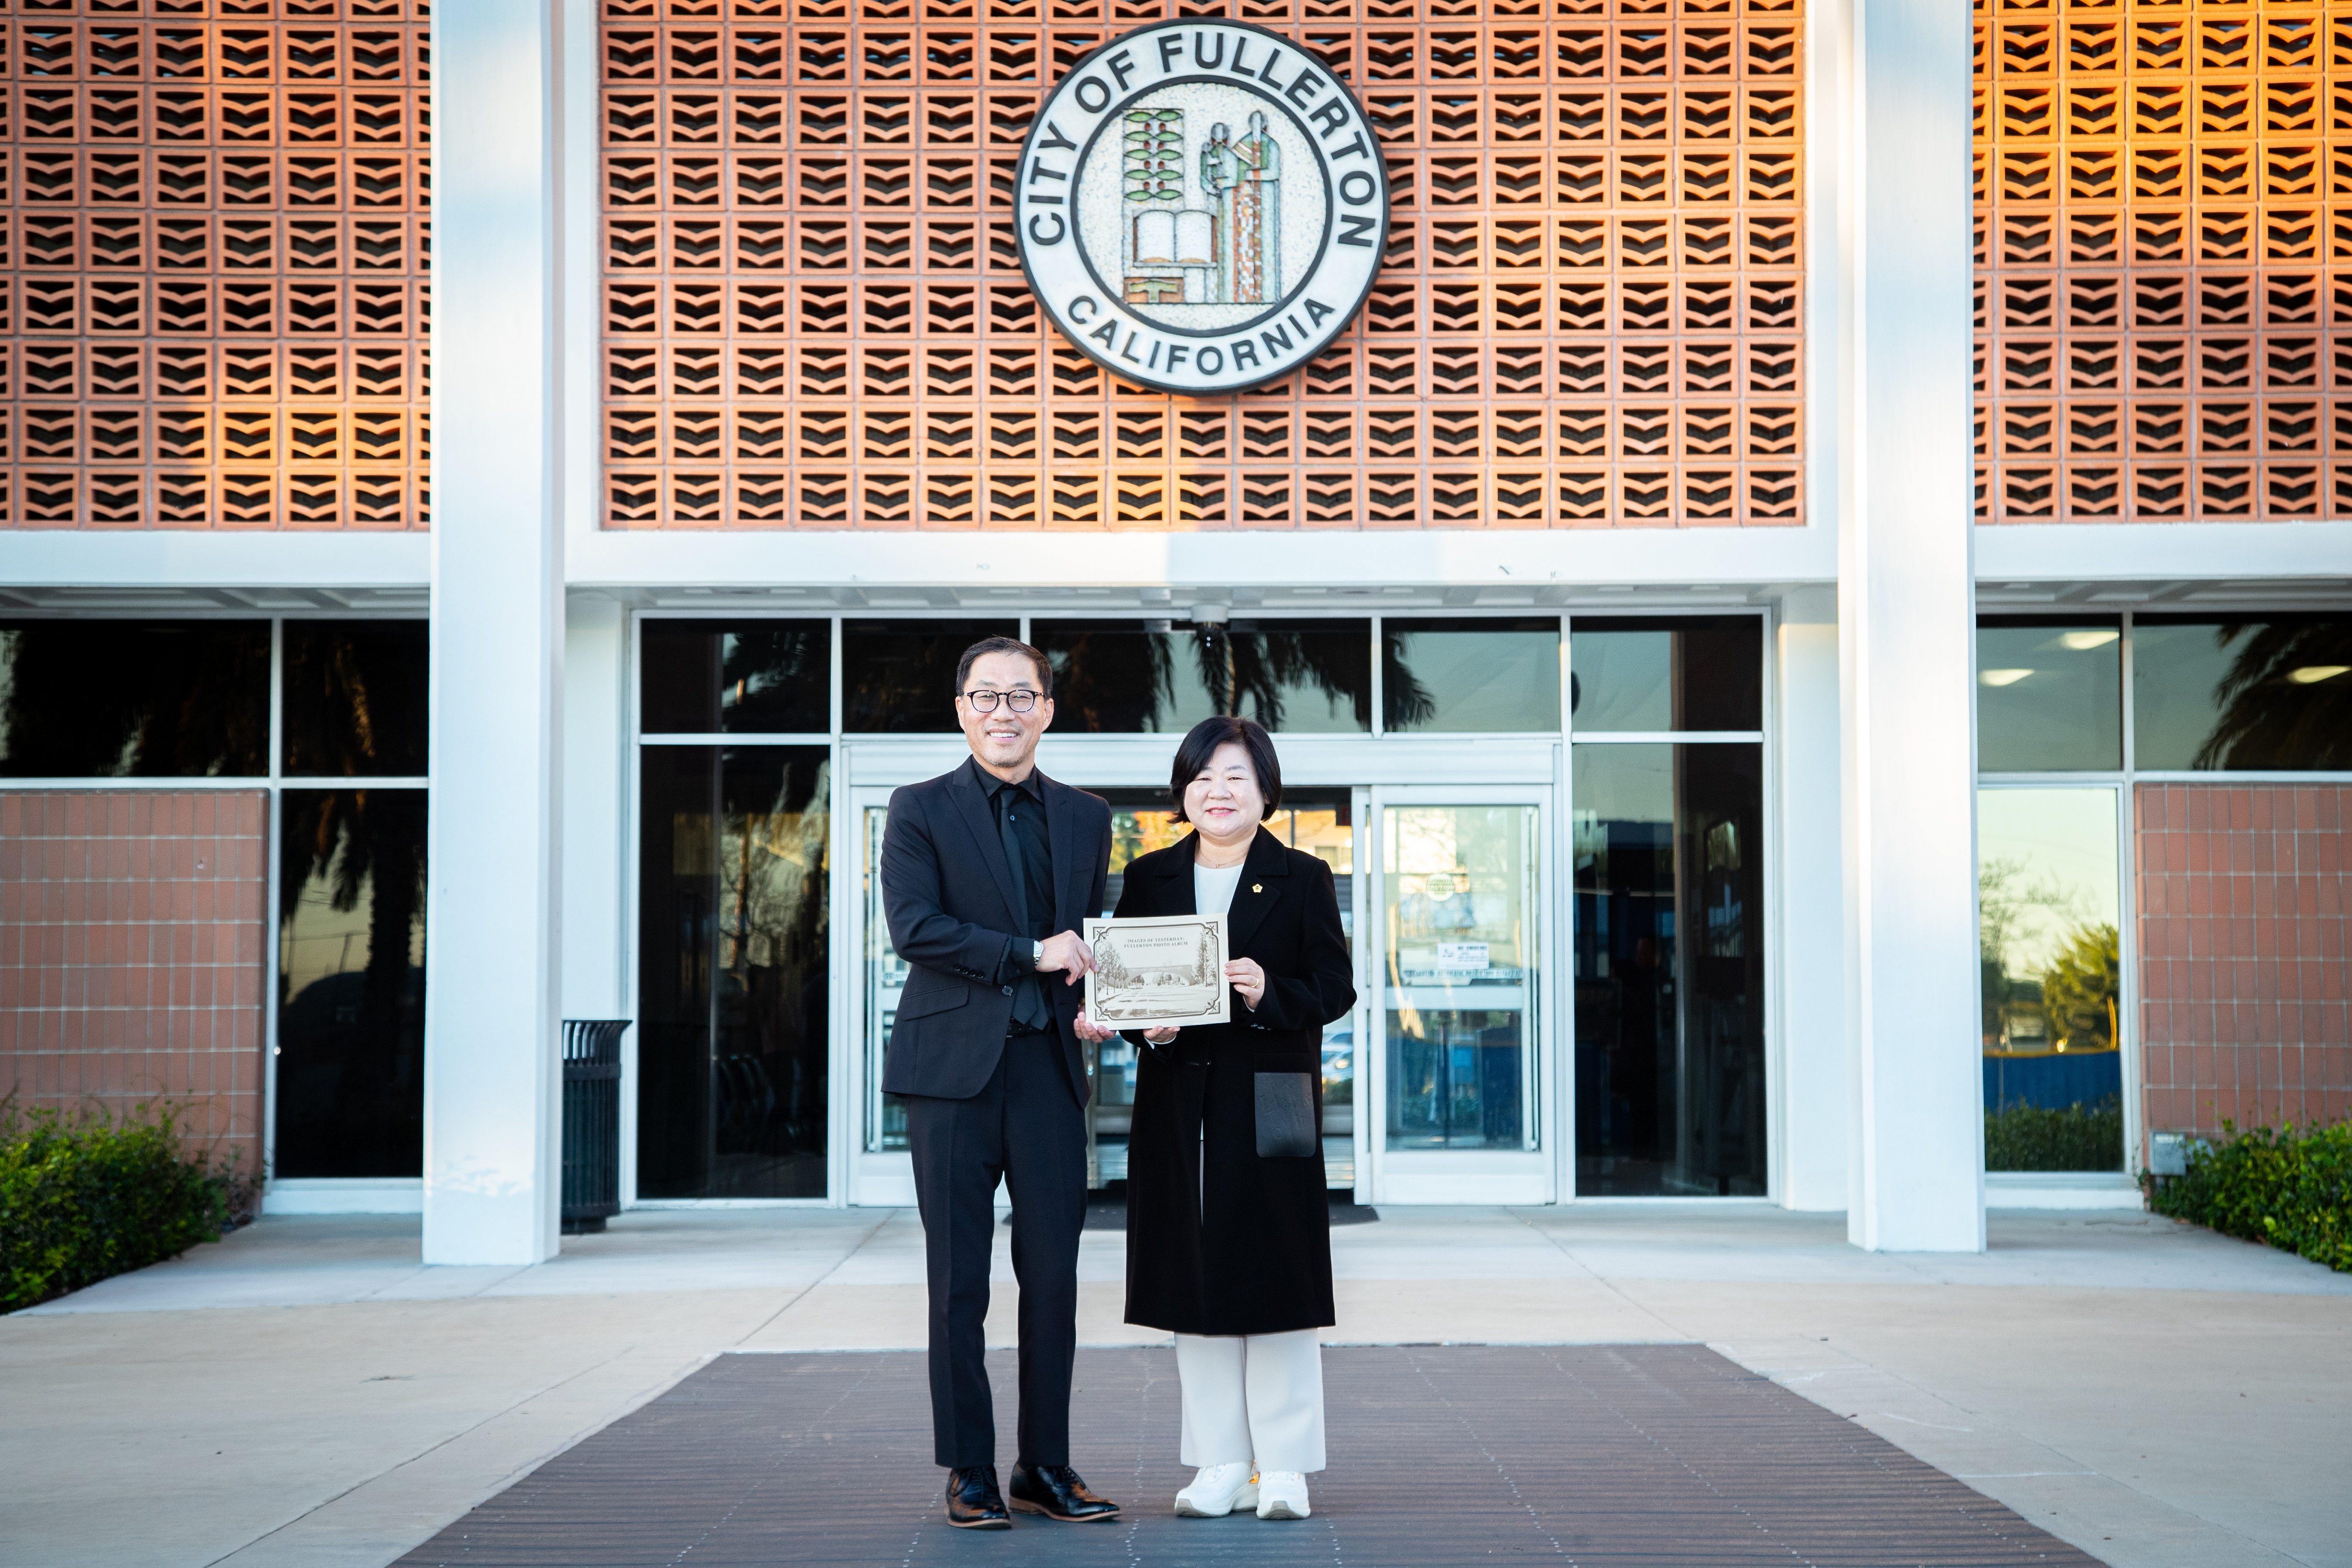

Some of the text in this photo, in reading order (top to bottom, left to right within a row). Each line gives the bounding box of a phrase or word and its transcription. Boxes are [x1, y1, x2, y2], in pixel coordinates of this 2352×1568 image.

[1028, 31, 1377, 247] CITY OF FULLERTON
[1068, 295, 1335, 376] CALIFORNIA
